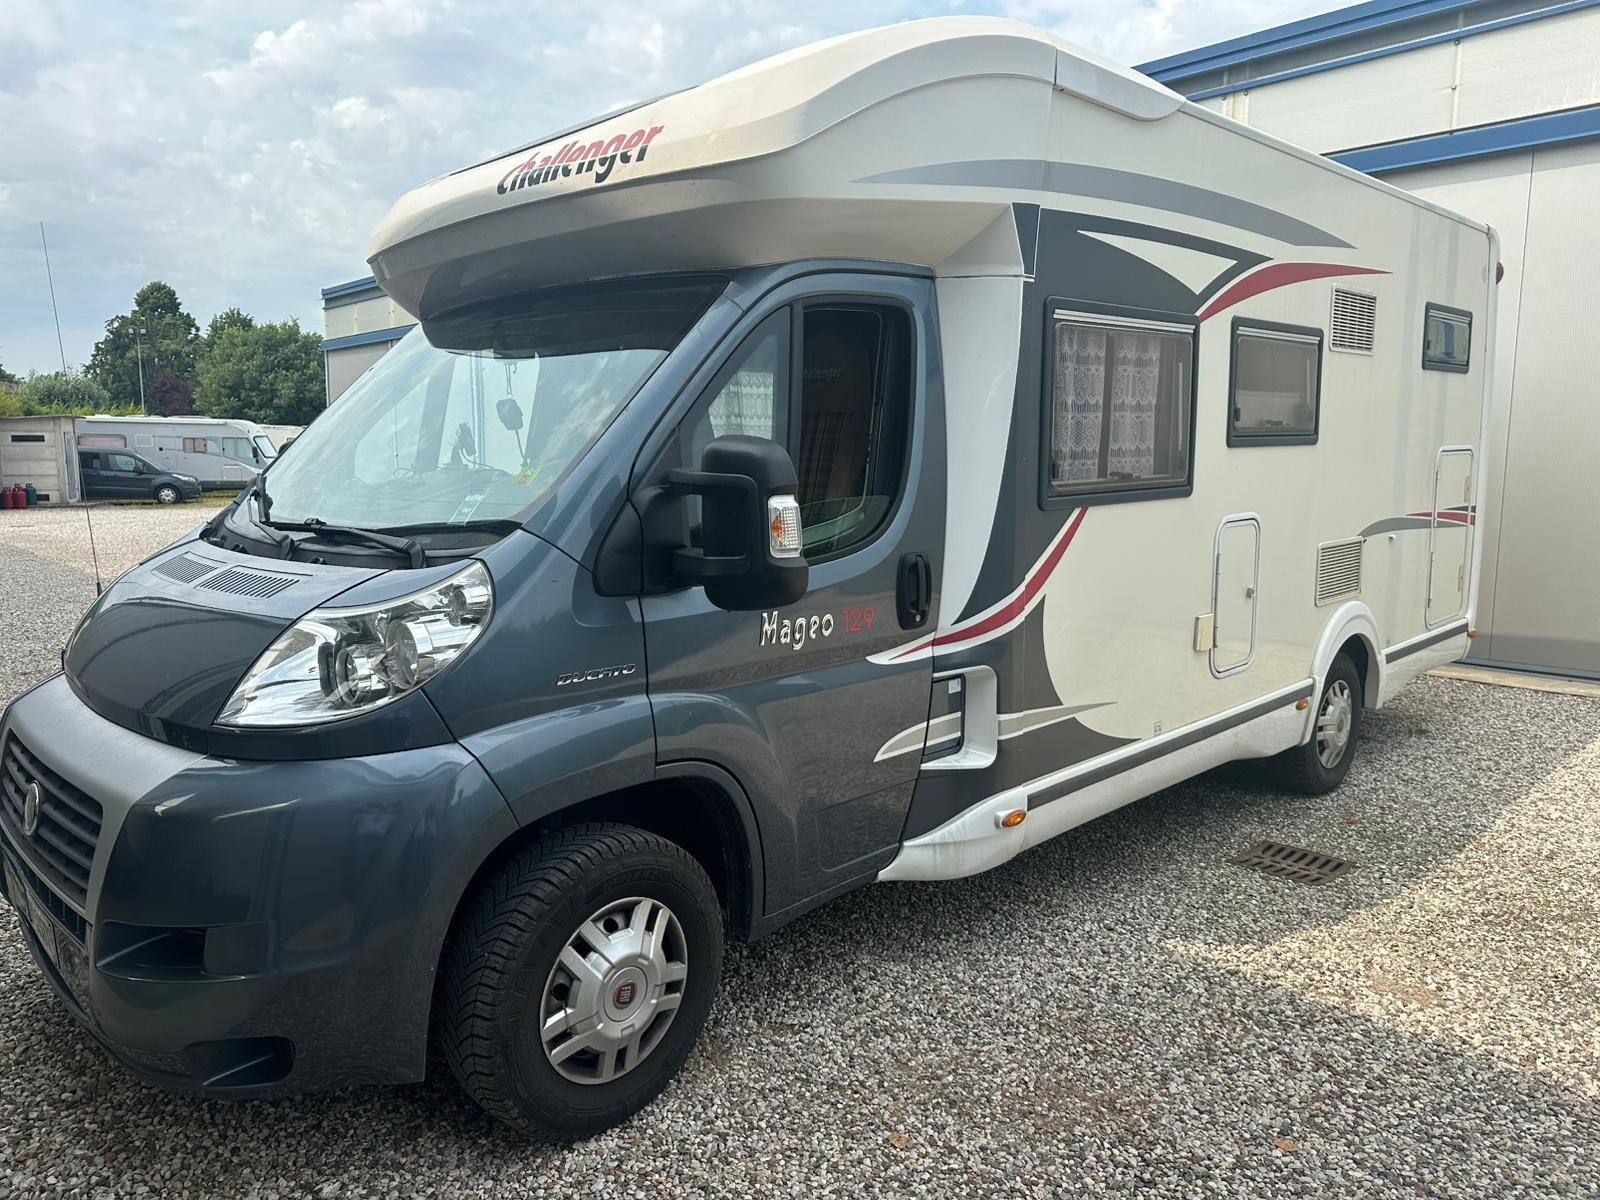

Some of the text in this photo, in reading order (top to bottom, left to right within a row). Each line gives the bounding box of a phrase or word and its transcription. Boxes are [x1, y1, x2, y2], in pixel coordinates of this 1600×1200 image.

[760, 607, 876, 650] Mageo 129
[556, 663, 637, 687] DUCATO
[619, 985, 631, 1002] FIAT
